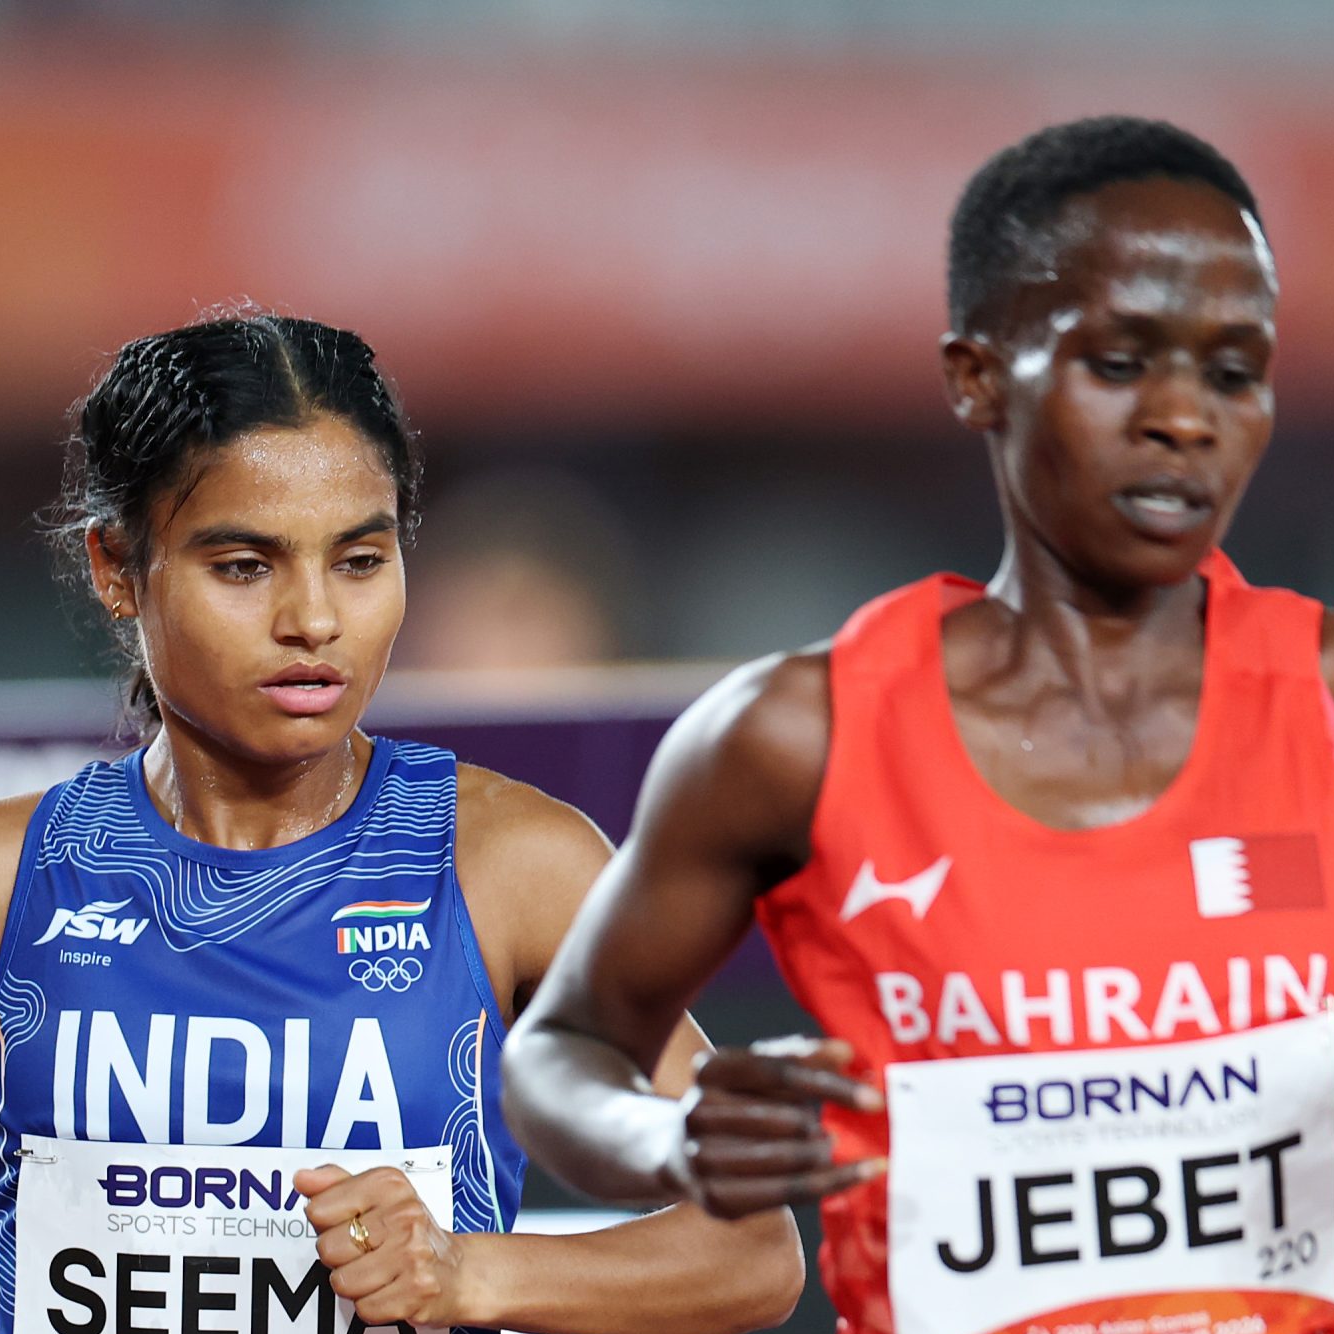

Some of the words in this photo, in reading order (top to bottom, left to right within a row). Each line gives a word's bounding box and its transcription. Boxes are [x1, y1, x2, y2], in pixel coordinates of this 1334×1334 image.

[32, 904, 150, 945] JSW
[337, 921, 431, 954] INDIA
[59, 949, 112, 967] Inspire
[875, 953, 1328, 1046] BAHRAIN
[53, 1009, 405, 1149] INDIA
[985, 1056, 1258, 1123] BORNAN
[97, 1164, 305, 1211] BORN
[937, 1132, 1301, 1274] JEBET
[107, 1213, 196, 1235] SPORTS
[206, 1216, 319, 1239] TECHNOL
[1257, 1230, 1318, 1280] 220
